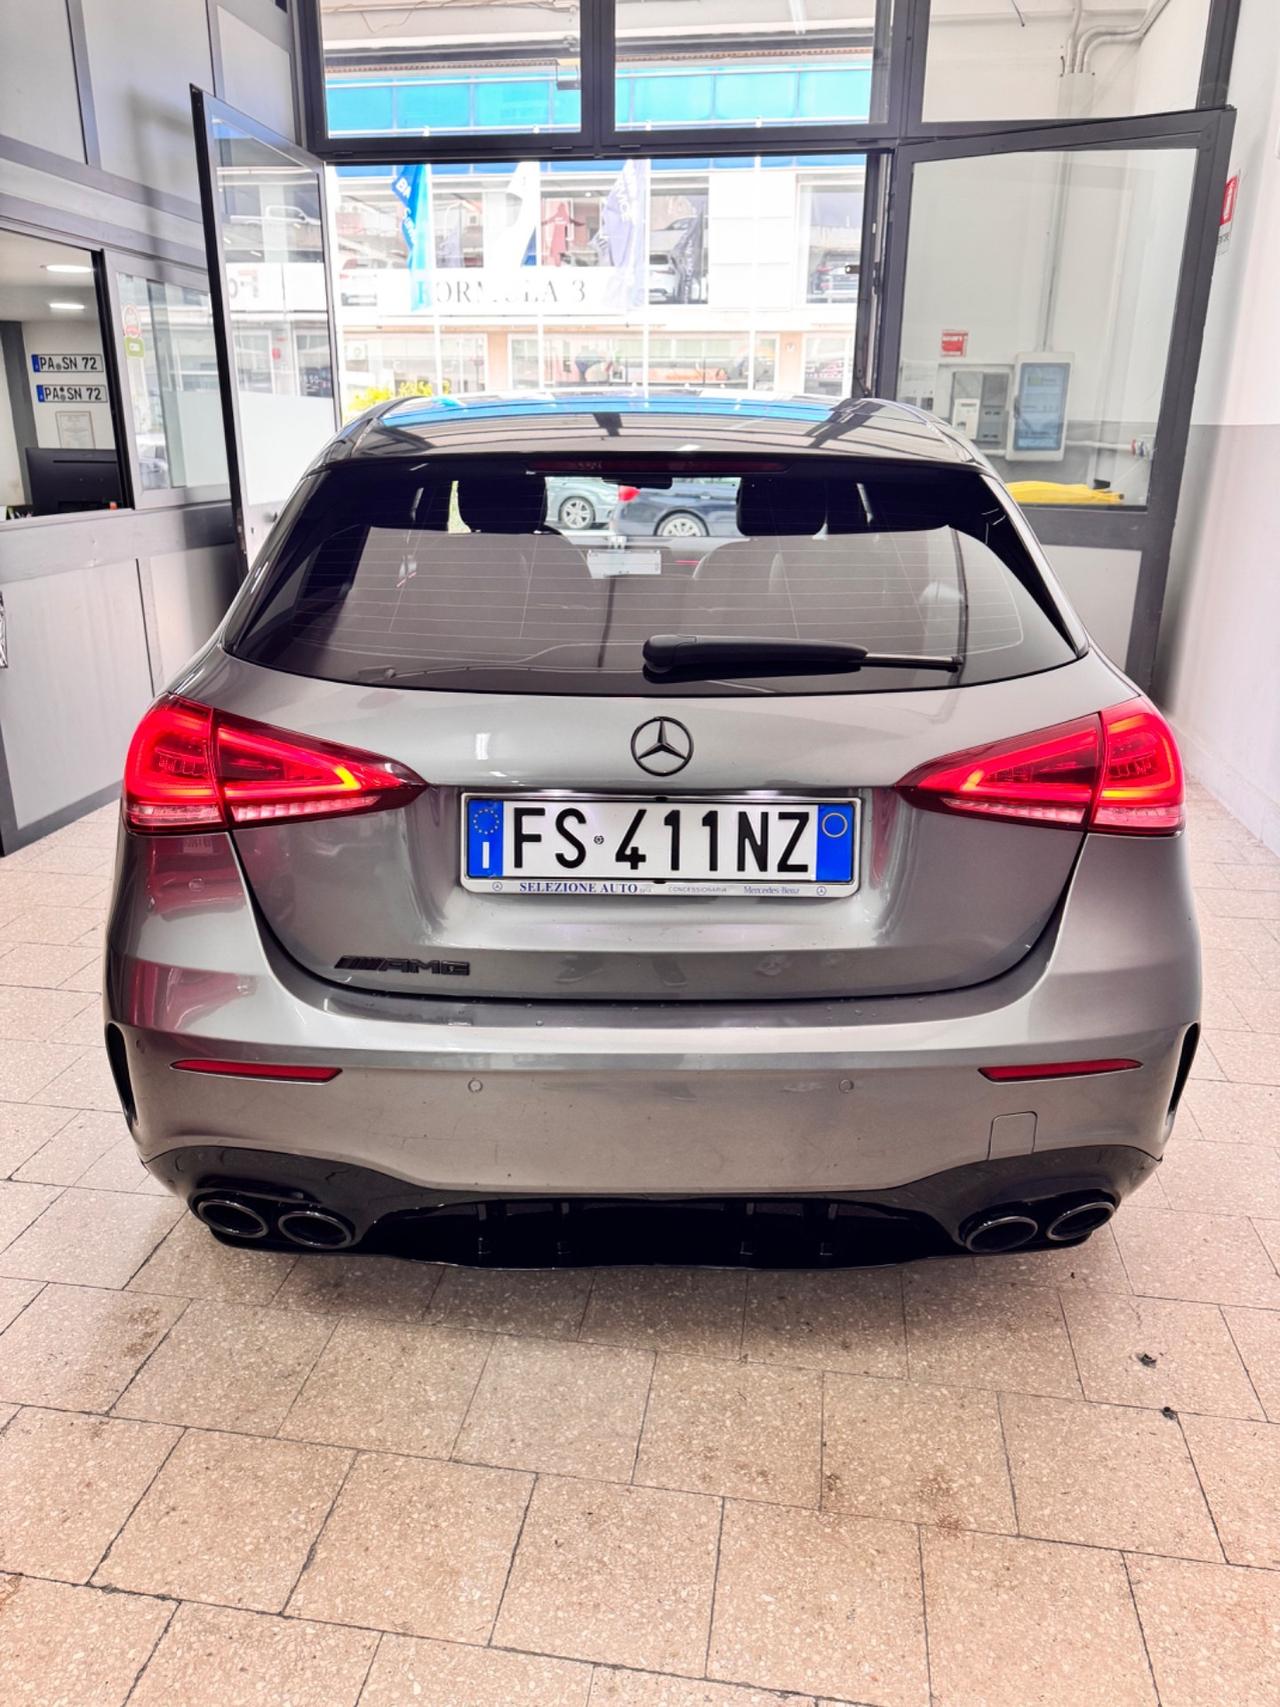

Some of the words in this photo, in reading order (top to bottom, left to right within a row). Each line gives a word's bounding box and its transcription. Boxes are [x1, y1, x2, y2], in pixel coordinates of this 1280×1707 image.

[571, 279, 587, 303] 3
[39, 356, 55, 370] PA
[62, 356, 78, 370] SN
[81, 356, 97, 370] 72
[44, 387, 59, 400] PA
[66, 387, 82, 401] SN
[86, 387, 102, 401] 72
[513, 807, 587, 869] FS
[615, 808, 810, 873] 411NZ
[519, 881, 597, 893] SELEZIONE
[600, 883, 638, 894] AUTO
[376, 956, 470, 976] AMG
